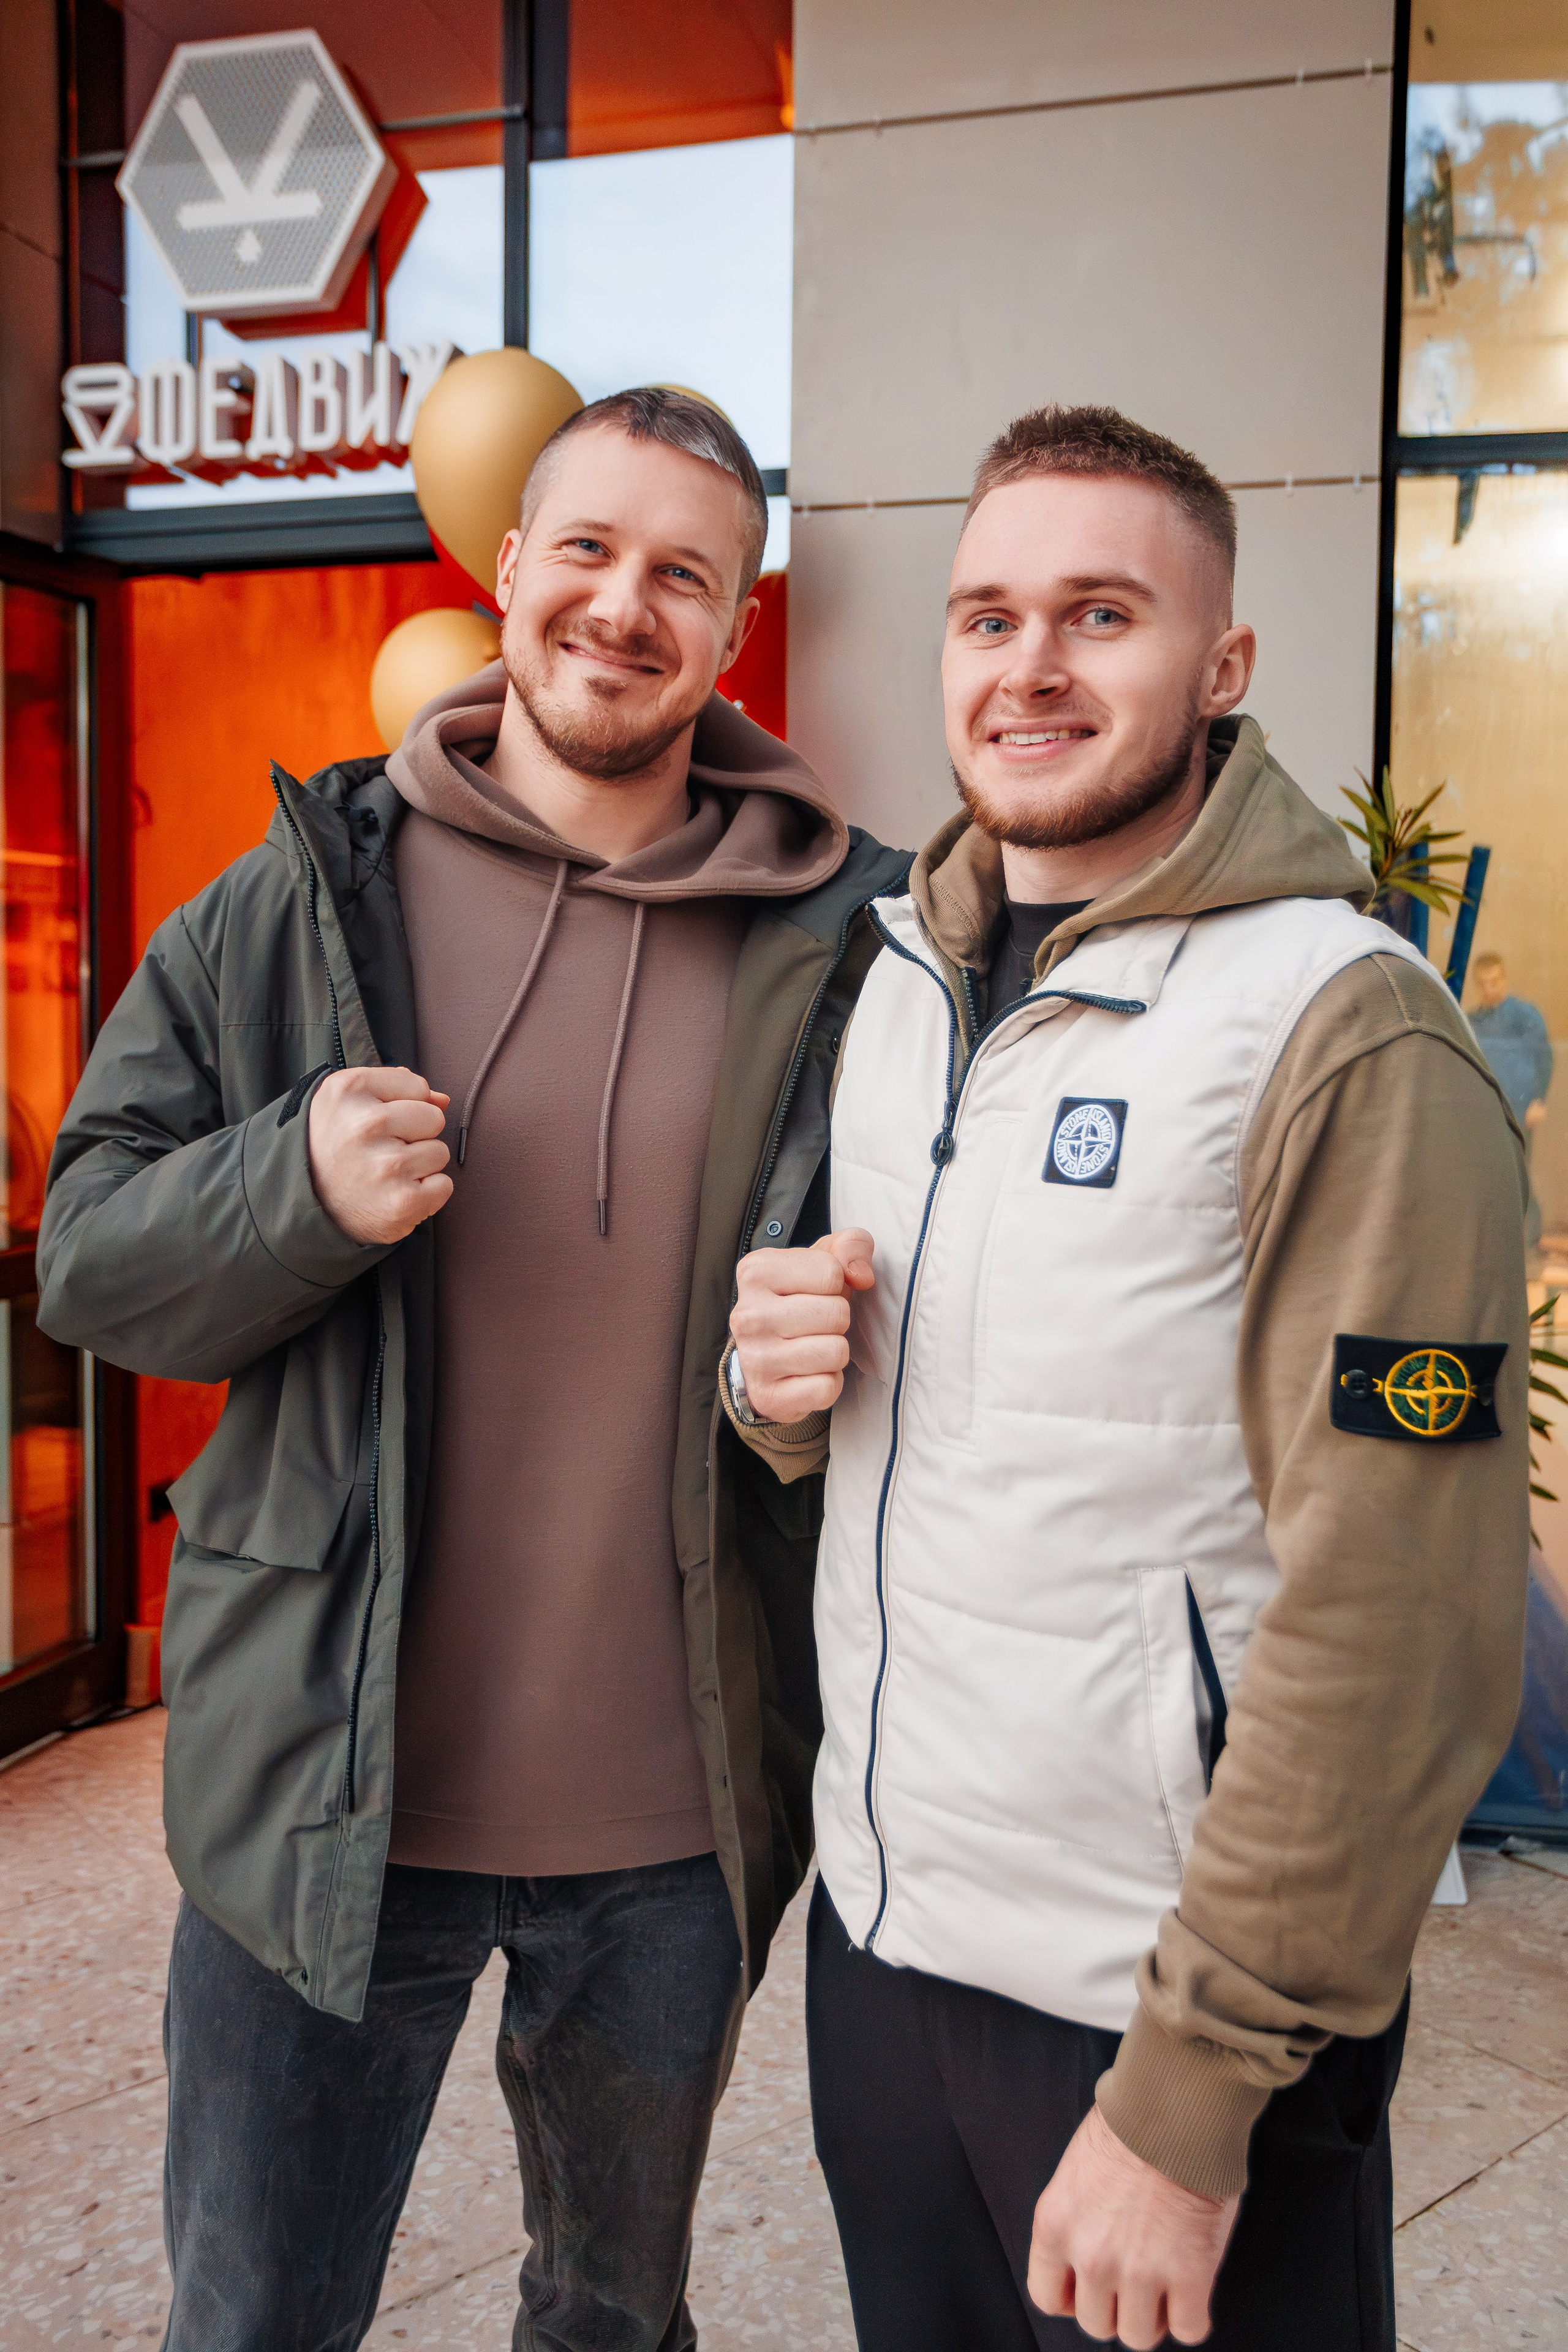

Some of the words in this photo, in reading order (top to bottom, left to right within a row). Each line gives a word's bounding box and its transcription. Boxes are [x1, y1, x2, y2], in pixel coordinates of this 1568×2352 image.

[1060, 1109, 1089, 1138] STONE
[1092, 1109, 1112, 1140] ISLAND
[1057, 1142, 1076, 1173] ISLAND
[1080, 1144, 1109, 1173] STONE
